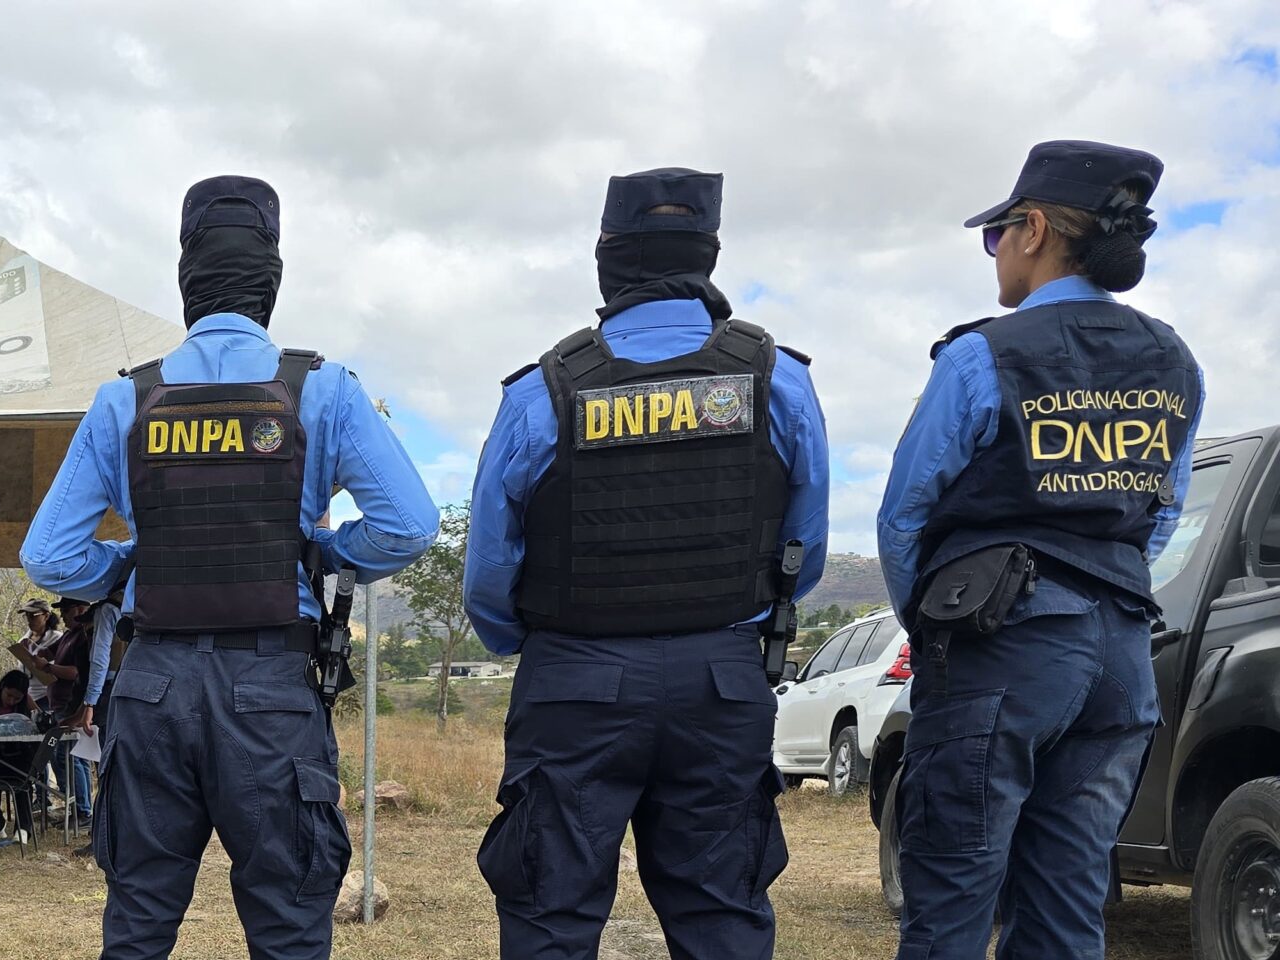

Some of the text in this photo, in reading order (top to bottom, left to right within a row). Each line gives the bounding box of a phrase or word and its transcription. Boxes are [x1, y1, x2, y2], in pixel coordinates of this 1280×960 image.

[586, 389, 699, 441] DNPA
[1022, 389, 1187, 420] POLICIA NACIONAL
[148, 418, 245, 454] DNPA
[1031, 418, 1172, 463] DNPA
[1037, 470, 1163, 493] ANTIDROGAS
